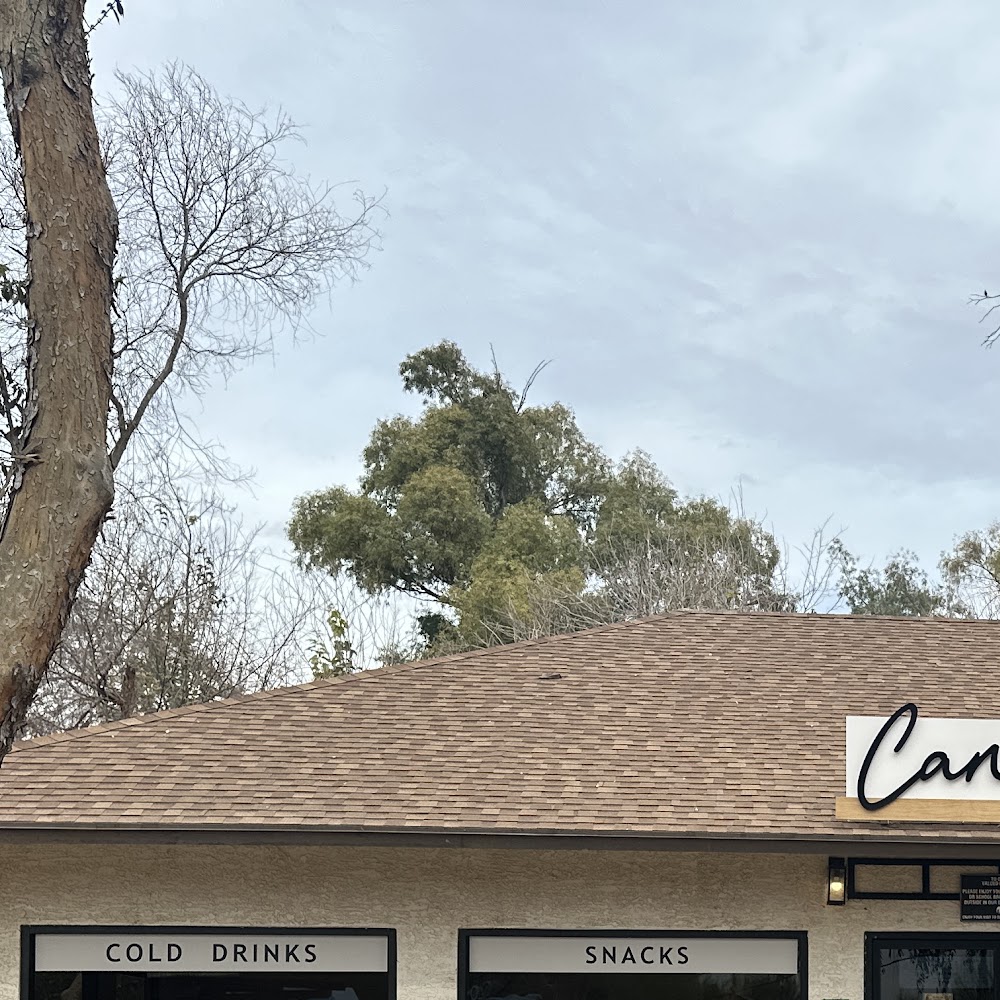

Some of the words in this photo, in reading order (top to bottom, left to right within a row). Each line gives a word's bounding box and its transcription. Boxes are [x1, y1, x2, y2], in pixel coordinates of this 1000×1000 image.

[107, 943, 182, 962] COLD
[212, 943, 318, 963] DRINKS
[585, 946, 690, 965] SNACKS
